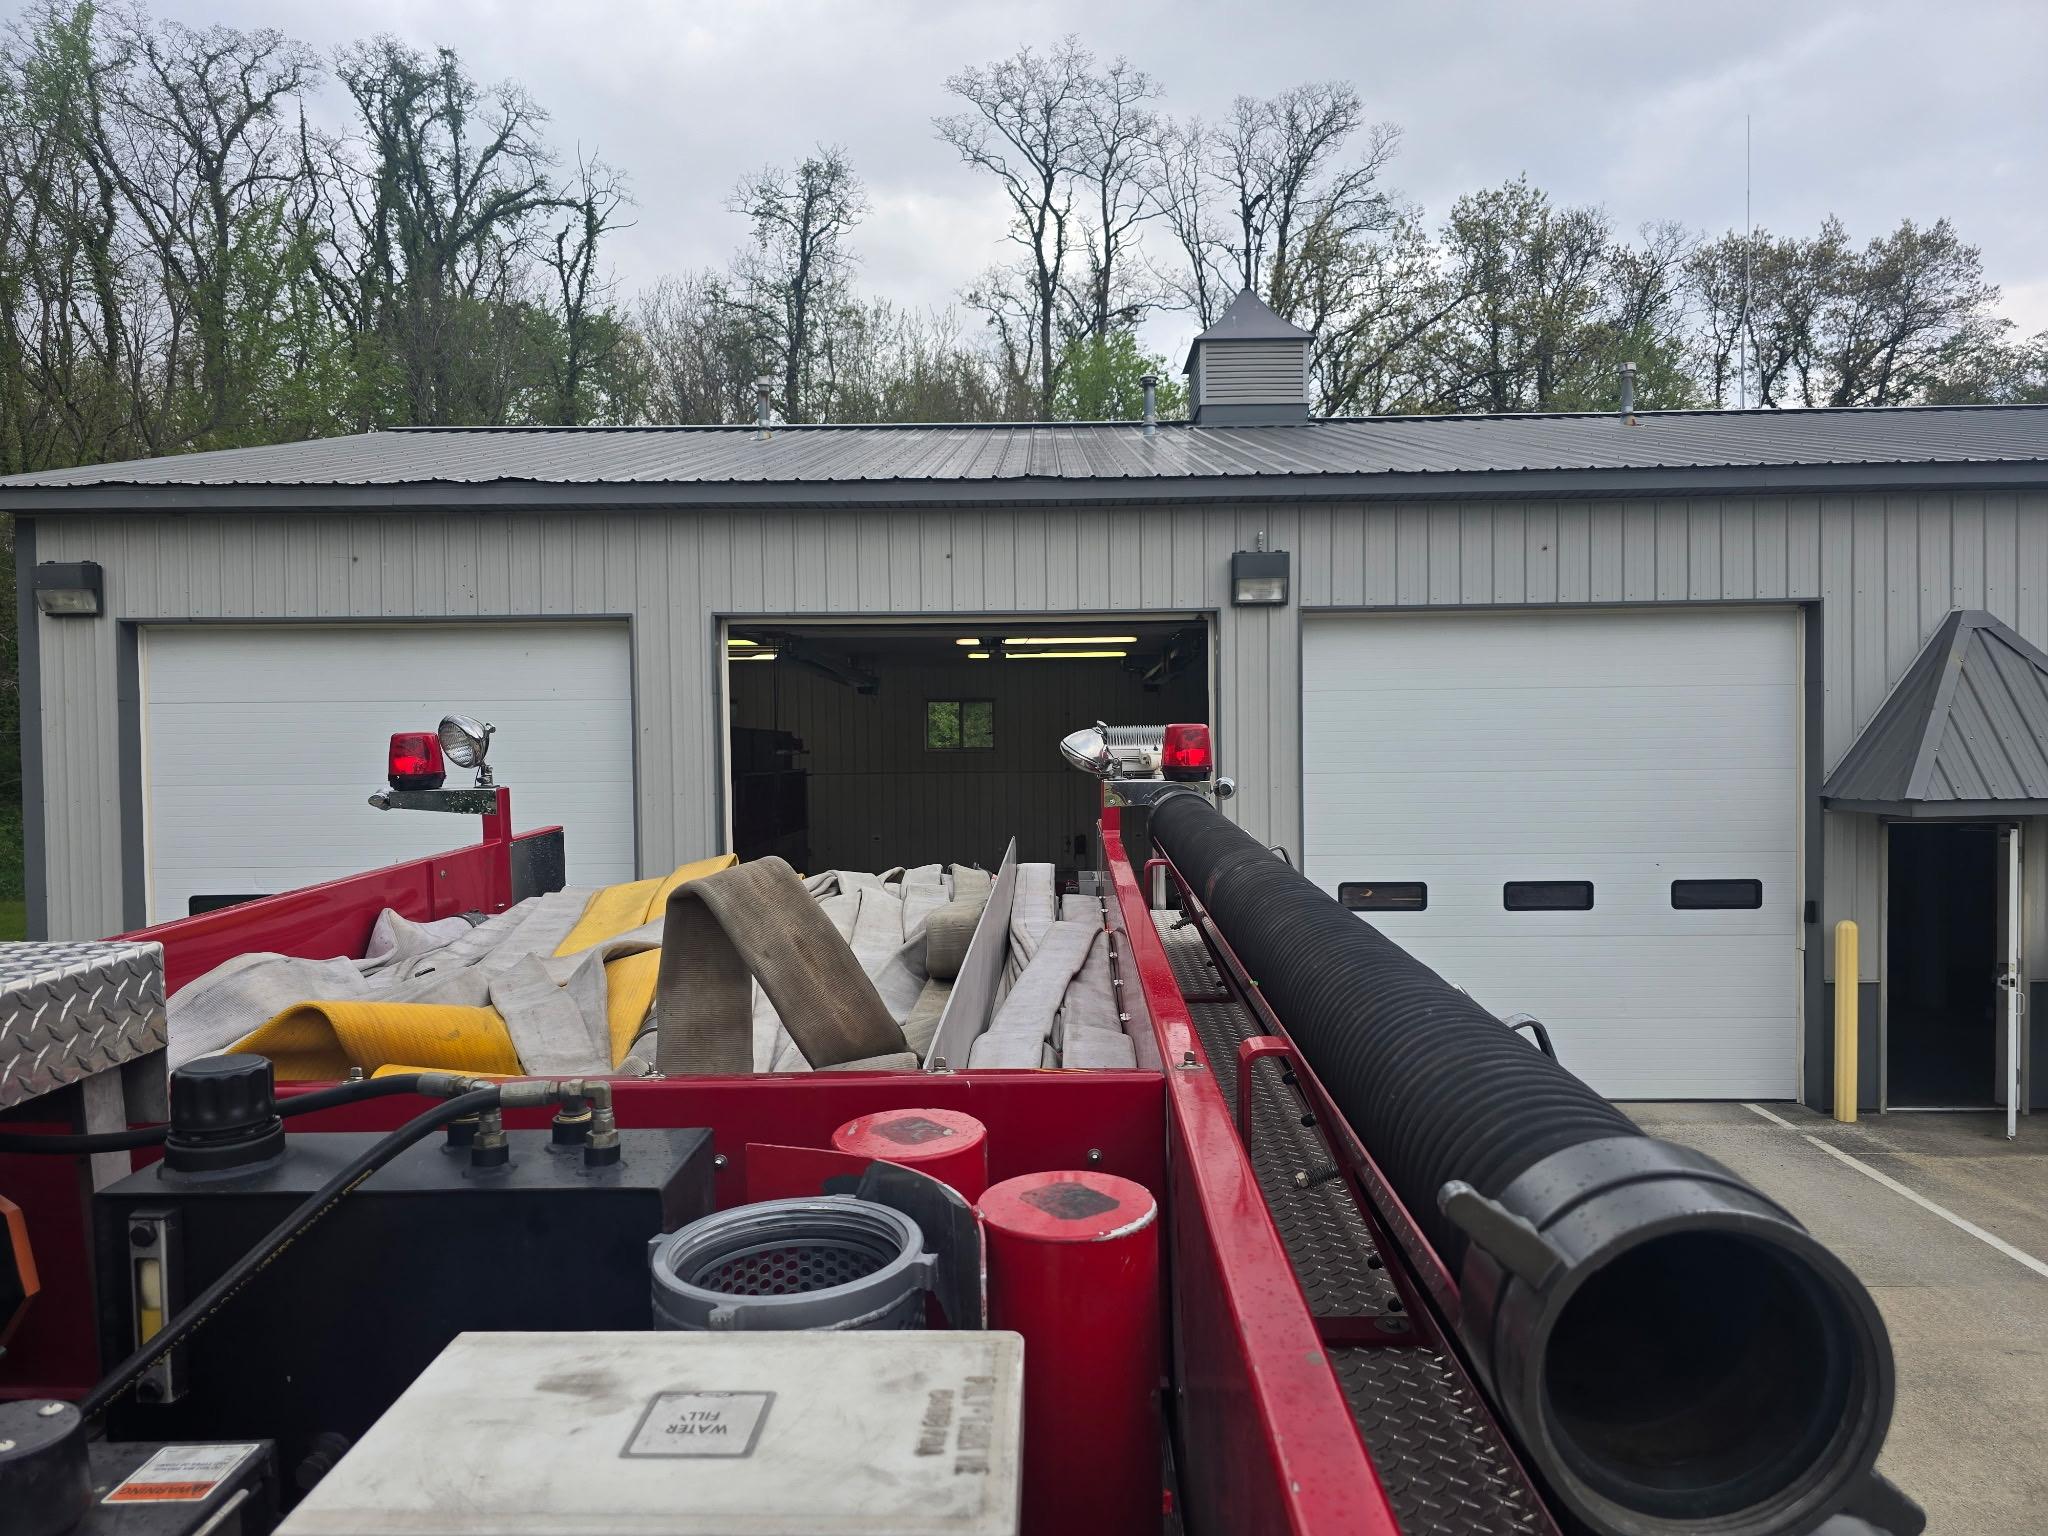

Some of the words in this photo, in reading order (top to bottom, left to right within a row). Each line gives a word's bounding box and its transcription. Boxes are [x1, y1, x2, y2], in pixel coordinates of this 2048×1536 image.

[689, 1411, 720, 1421] FILL
[666, 1424, 728, 1434] WATER
[119, 1485, 192, 1495] WARNING
